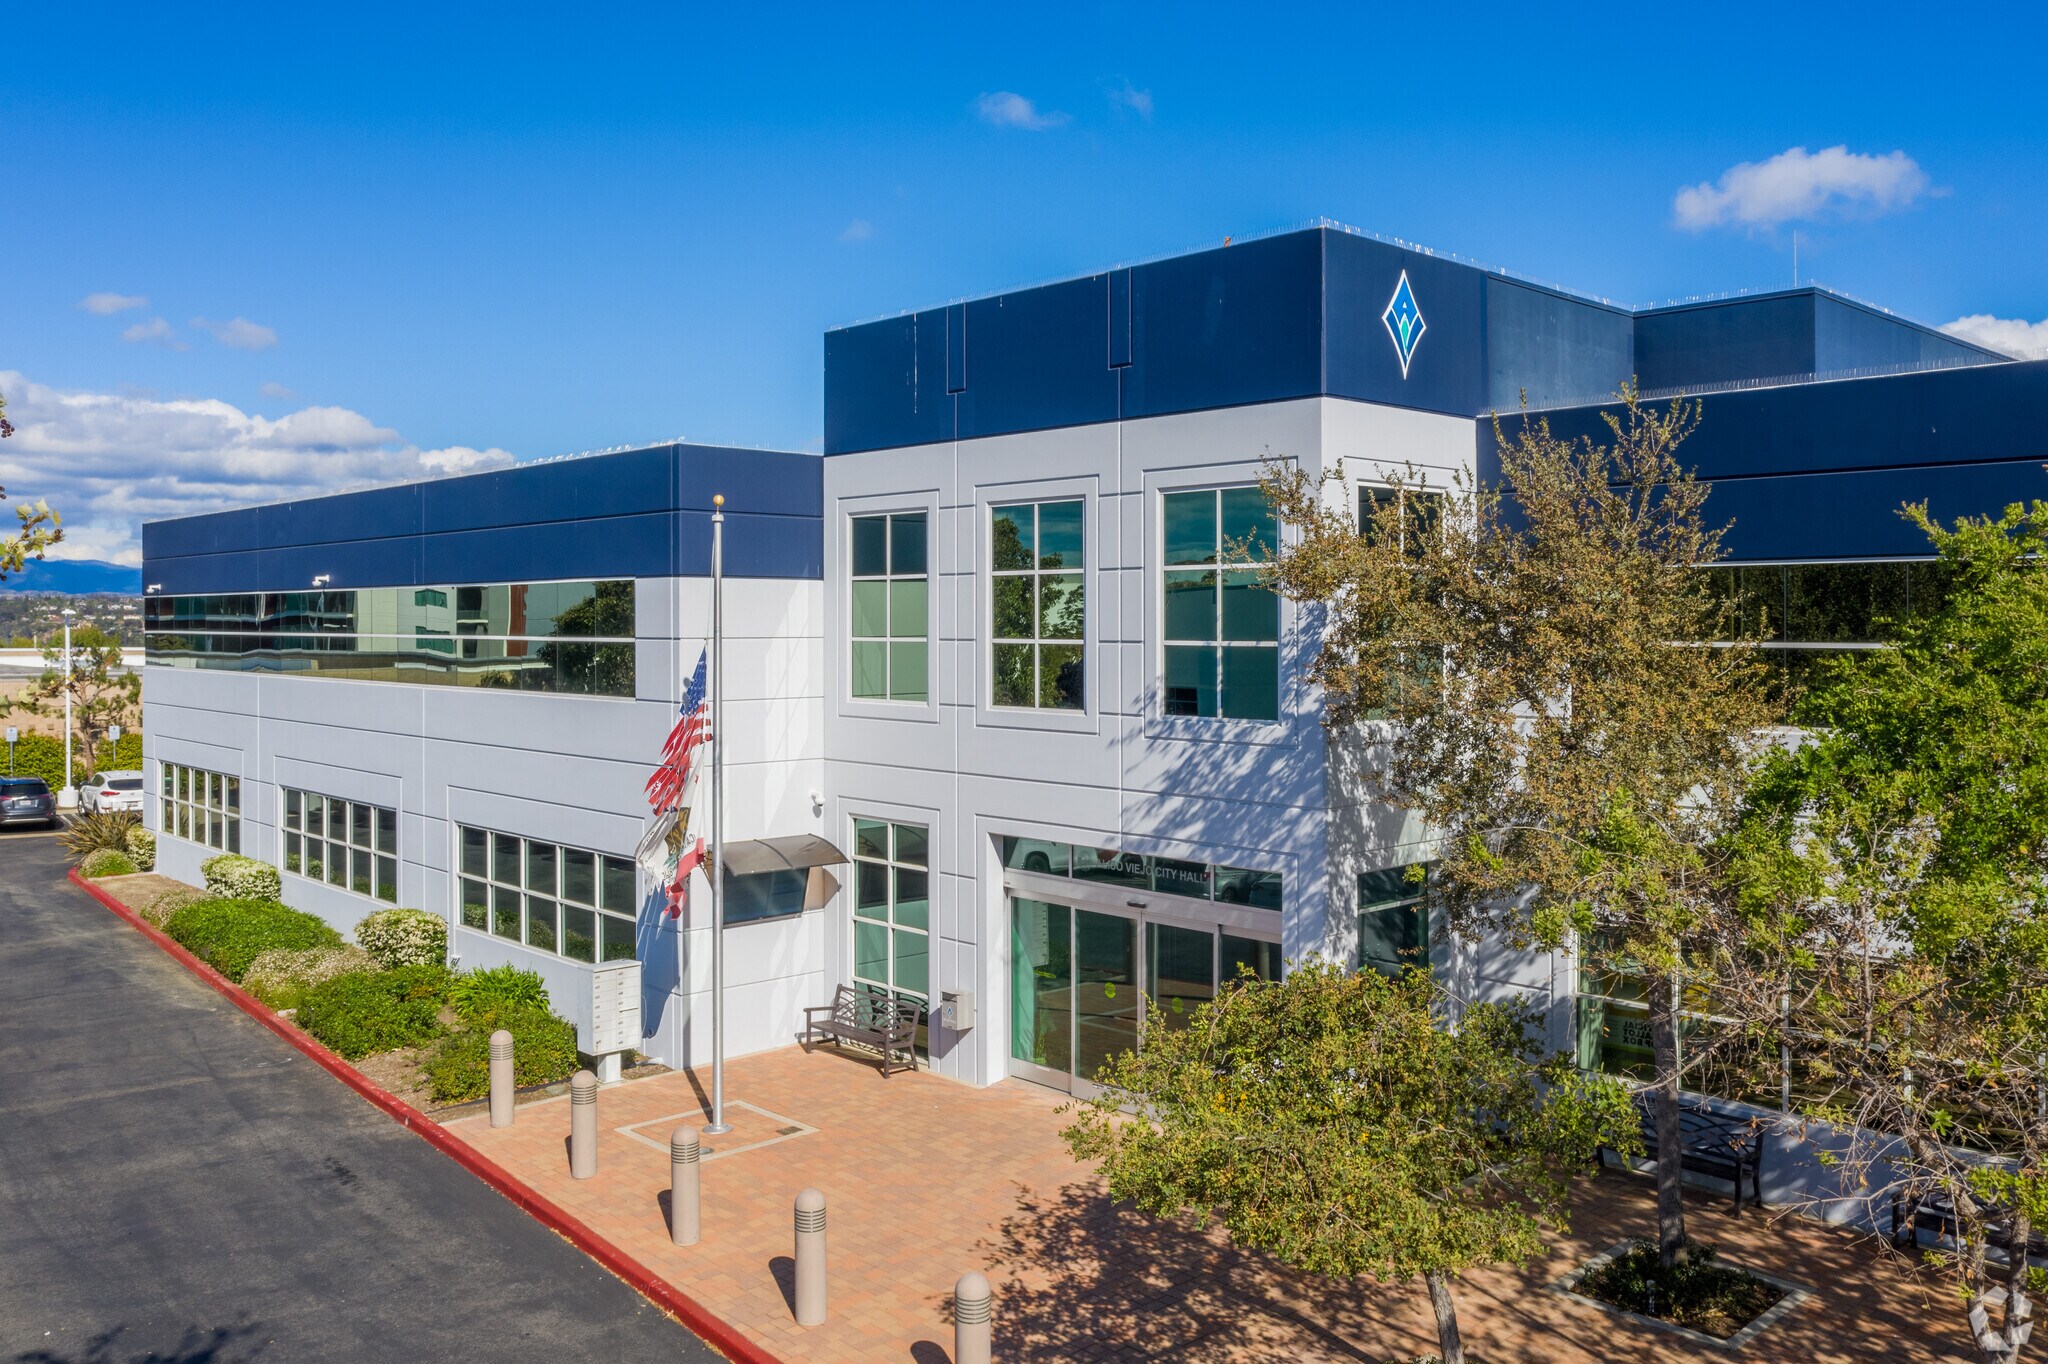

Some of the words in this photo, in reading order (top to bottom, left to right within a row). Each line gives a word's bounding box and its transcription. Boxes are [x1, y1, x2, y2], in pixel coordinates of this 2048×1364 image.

[1125, 862, 1153, 876] VIEJO
[1155, 866, 1177, 880] CITY
[1179, 870, 1205, 884] HALL
